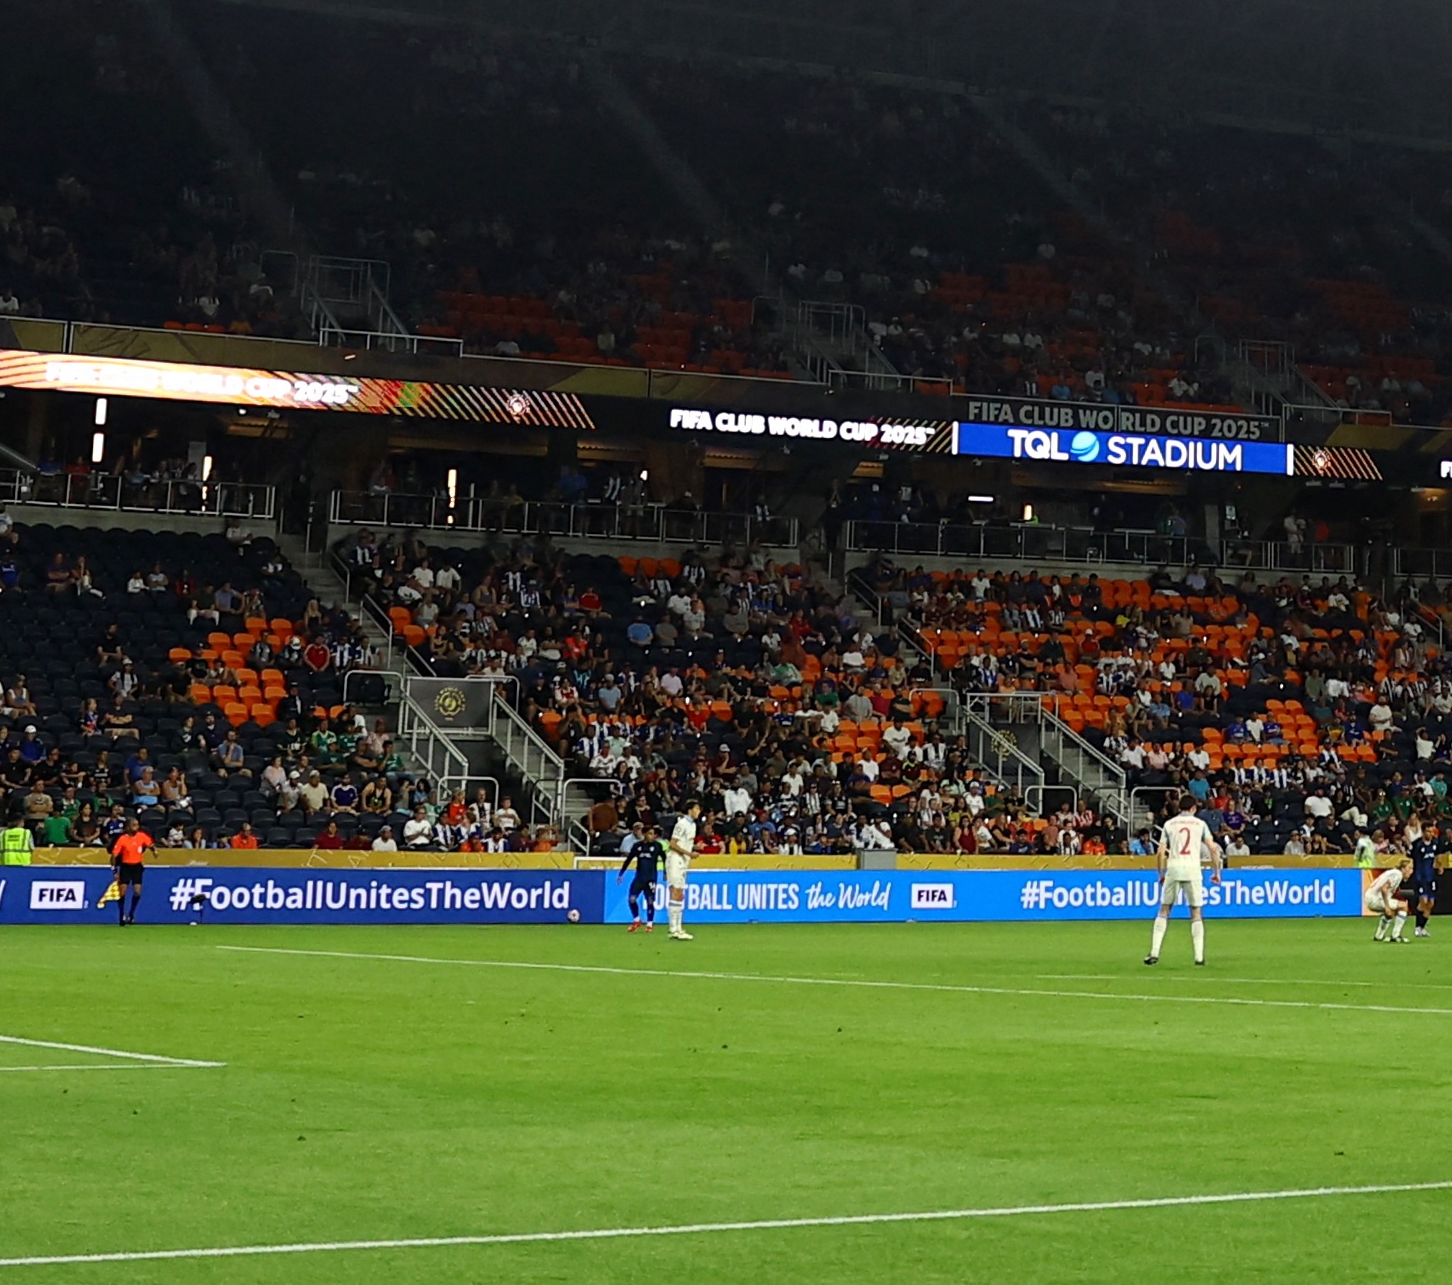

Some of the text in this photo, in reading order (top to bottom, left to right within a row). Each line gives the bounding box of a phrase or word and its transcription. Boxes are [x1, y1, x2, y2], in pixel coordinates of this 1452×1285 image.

[246, 377, 292, 399] CUP
[670, 408, 713, 430] FIFA
[715, 412, 766, 435] CLUB
[768, 416, 838, 440] WORLD
[839, 421, 879, 442] CUP
[968, 401, 1010, 424] FIFA
[1019, 405, 1074, 429] CLUB
[1079, 408, 1161, 435] WORLD
[1165, 415, 1205, 436] CUP
[1007, 429, 1242, 472] TQL STADIUM
[1179, 826, 1191, 855] 2
[36, 886, 78, 904] FIFA
[169, 877, 570, 912] #FootballUnitesTheWorld
[737, 882, 799, 910] UNITES
[805, 883, 836, 909] the
[837, 880, 891, 911] World
[917, 889, 948, 903] FIFA
